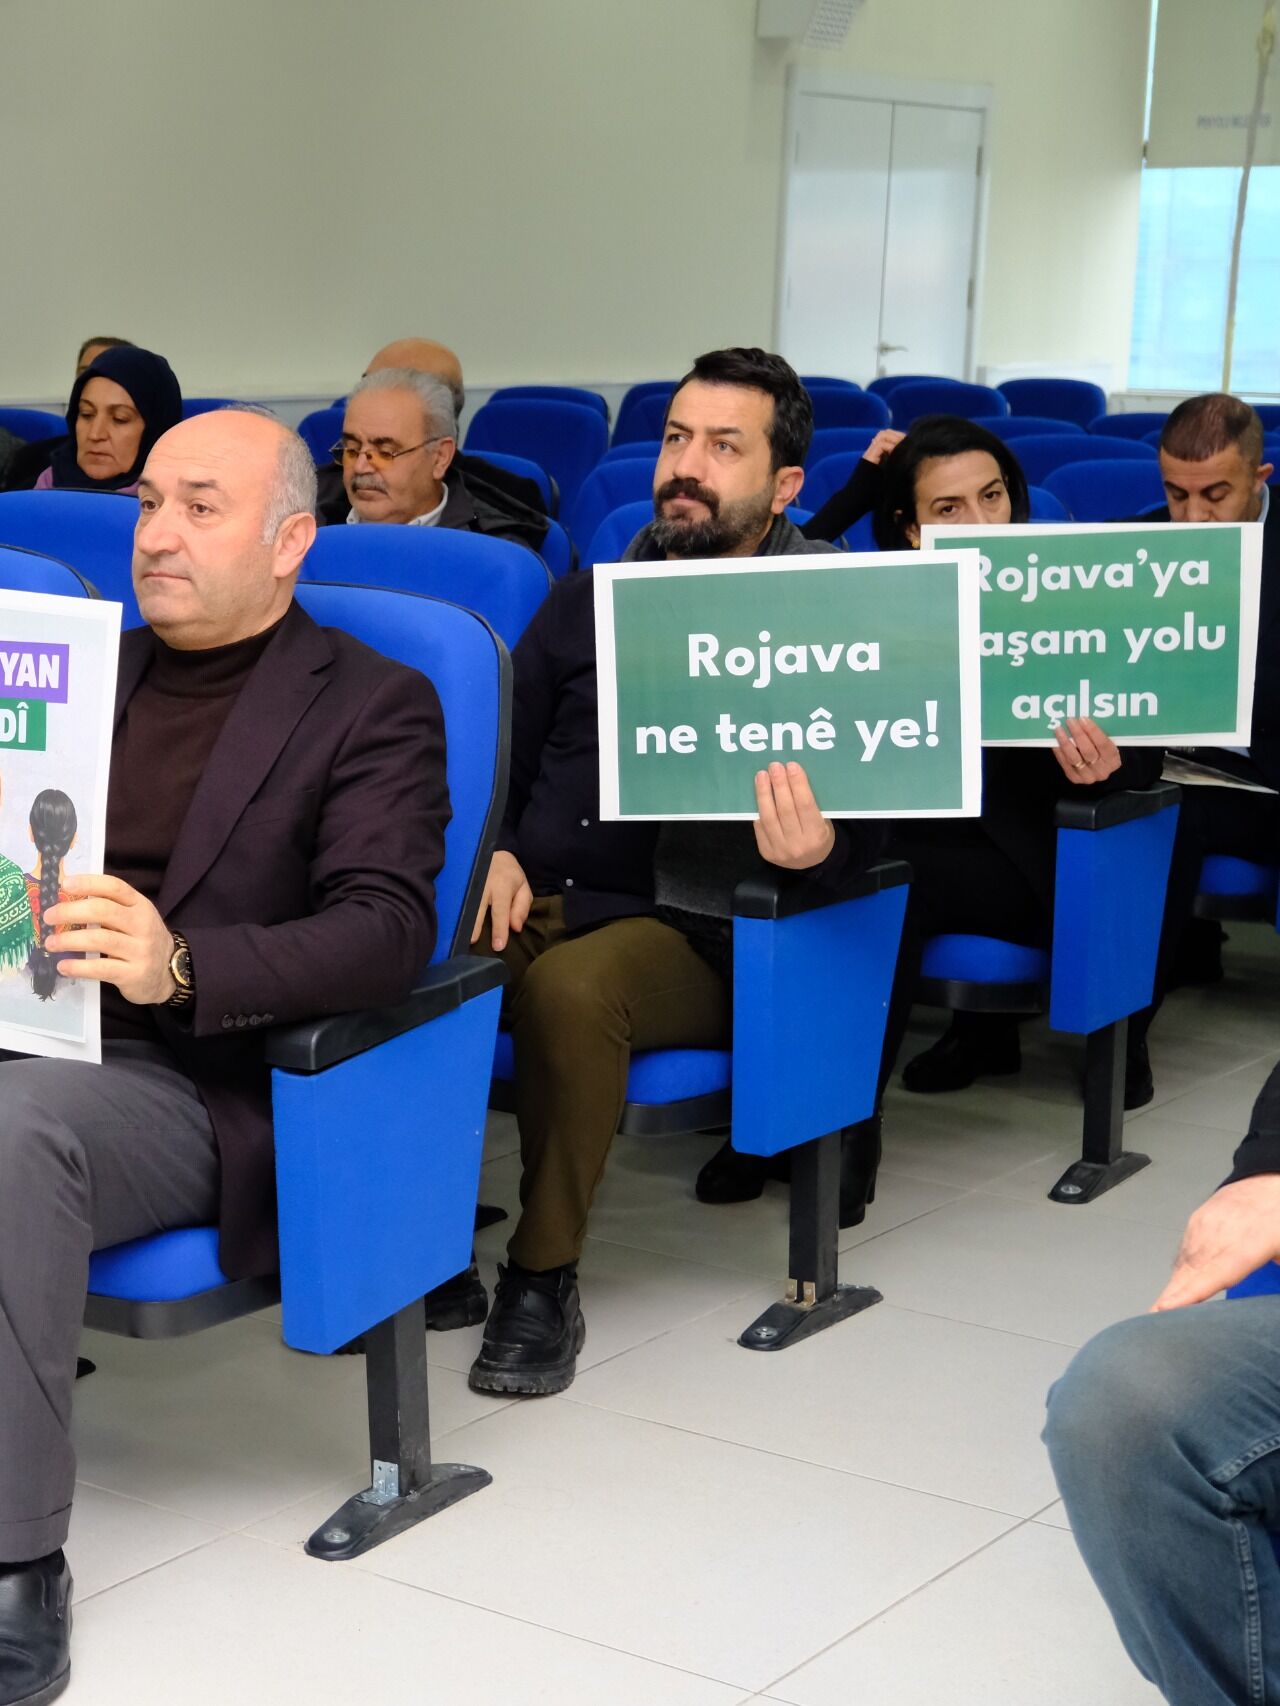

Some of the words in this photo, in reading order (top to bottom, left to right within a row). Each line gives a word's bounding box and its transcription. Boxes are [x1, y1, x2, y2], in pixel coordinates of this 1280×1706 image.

[688, 630, 880, 688] Rojava
[980, 628, 1107, 667] aşam
[1123, 611, 1226, 663] yolu
[635, 724, 698, 754] ne
[715, 706, 837, 753] tenê
[854, 700, 940, 762] ye!
[1011, 679, 1158, 730] açılsın
